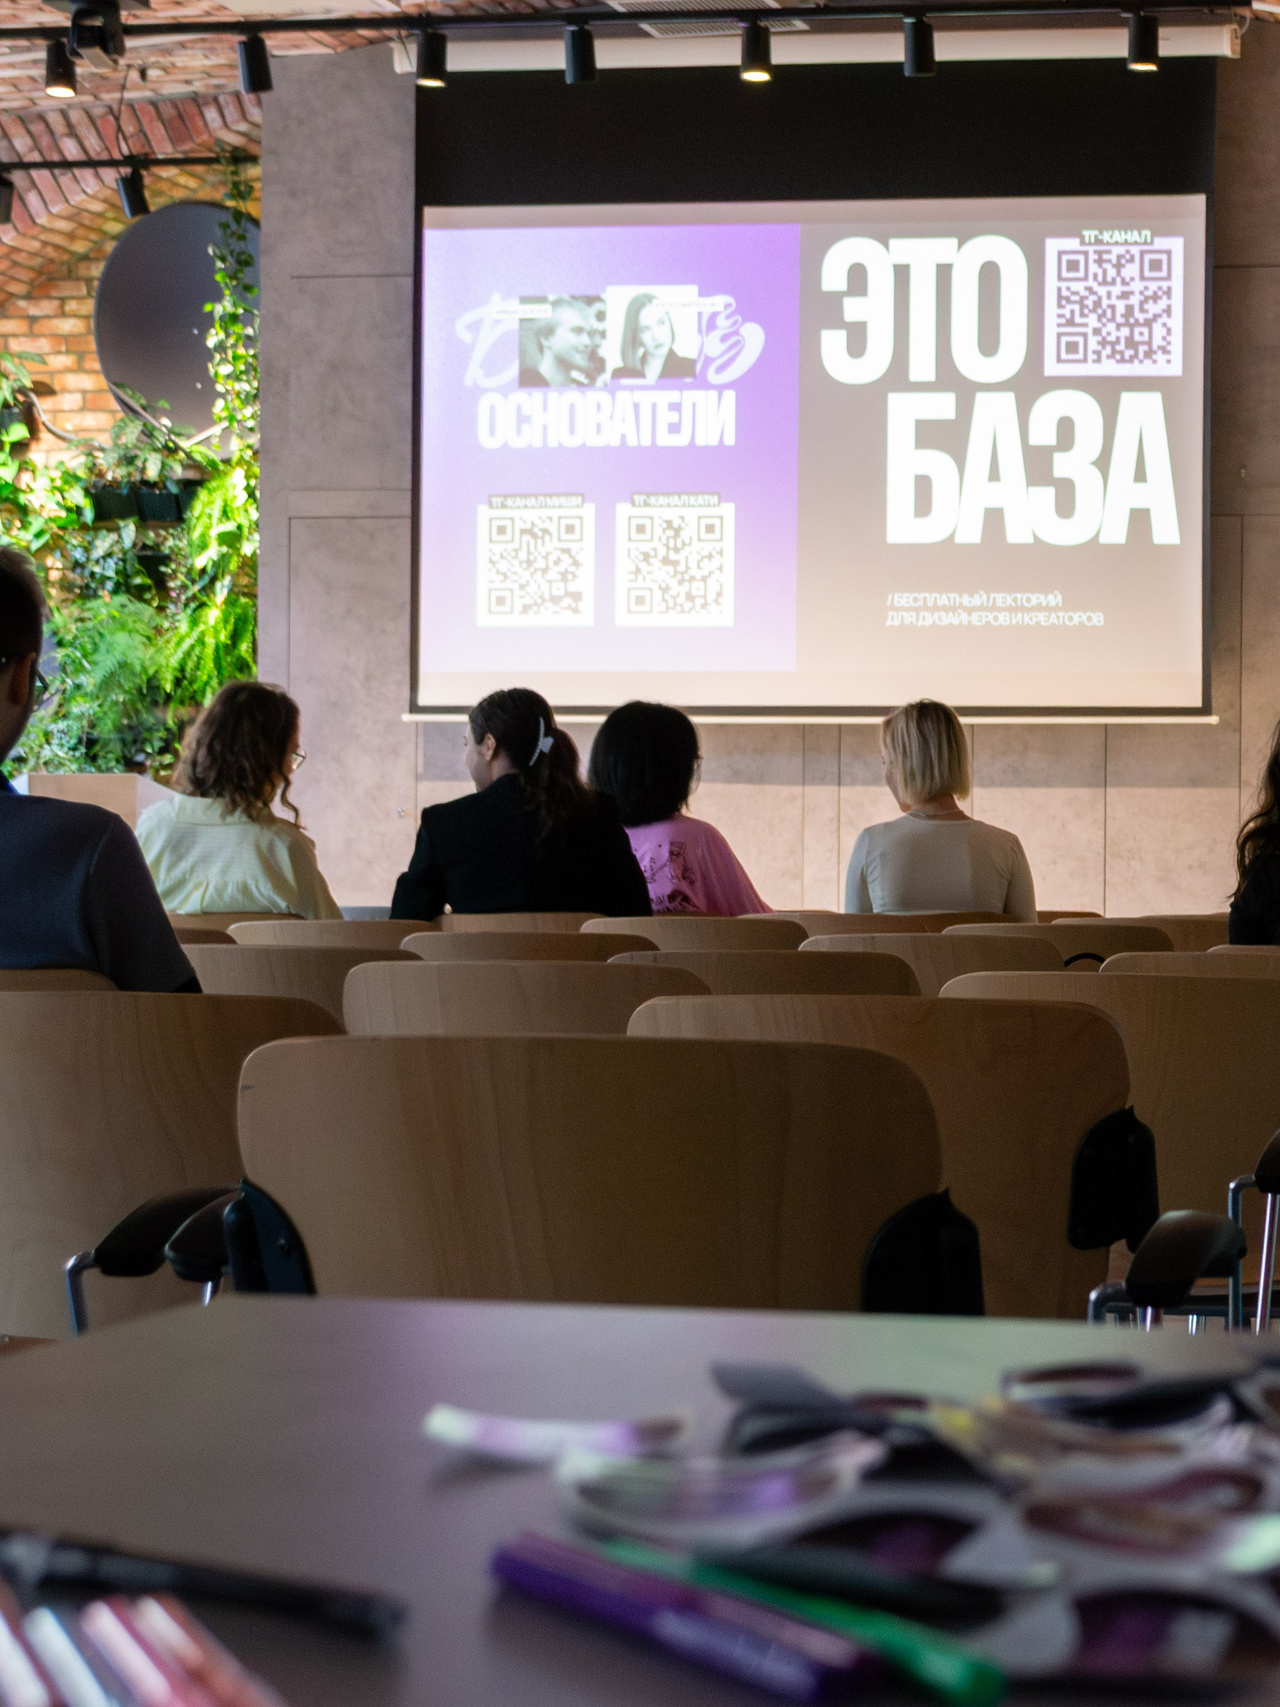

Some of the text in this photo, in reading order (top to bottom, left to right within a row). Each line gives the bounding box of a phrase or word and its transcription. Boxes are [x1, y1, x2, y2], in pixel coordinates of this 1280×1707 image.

[1082, 229, 1152, 244] ТГ-КАНАЛ
[820, 234, 1028, 385] ЭТО
[477, 390, 736, 449] ОСНОВАТЕЛИ
[886, 389, 1181, 546] БАЗА
[491, 496, 547, 507] ТГ-КАНАЛ
[634, 495, 718, 506] ТГ-КАНАЛ КАТИ
[894, 591, 987, 607] БЕСПЛАТНЫЙ
[988, 591, 1062, 607] ЛЕКТОРИЙ
[886, 609, 1105, 626] ДЛЯ ДИЗАЙНЕРОВ И КРЕАТОРОВ
